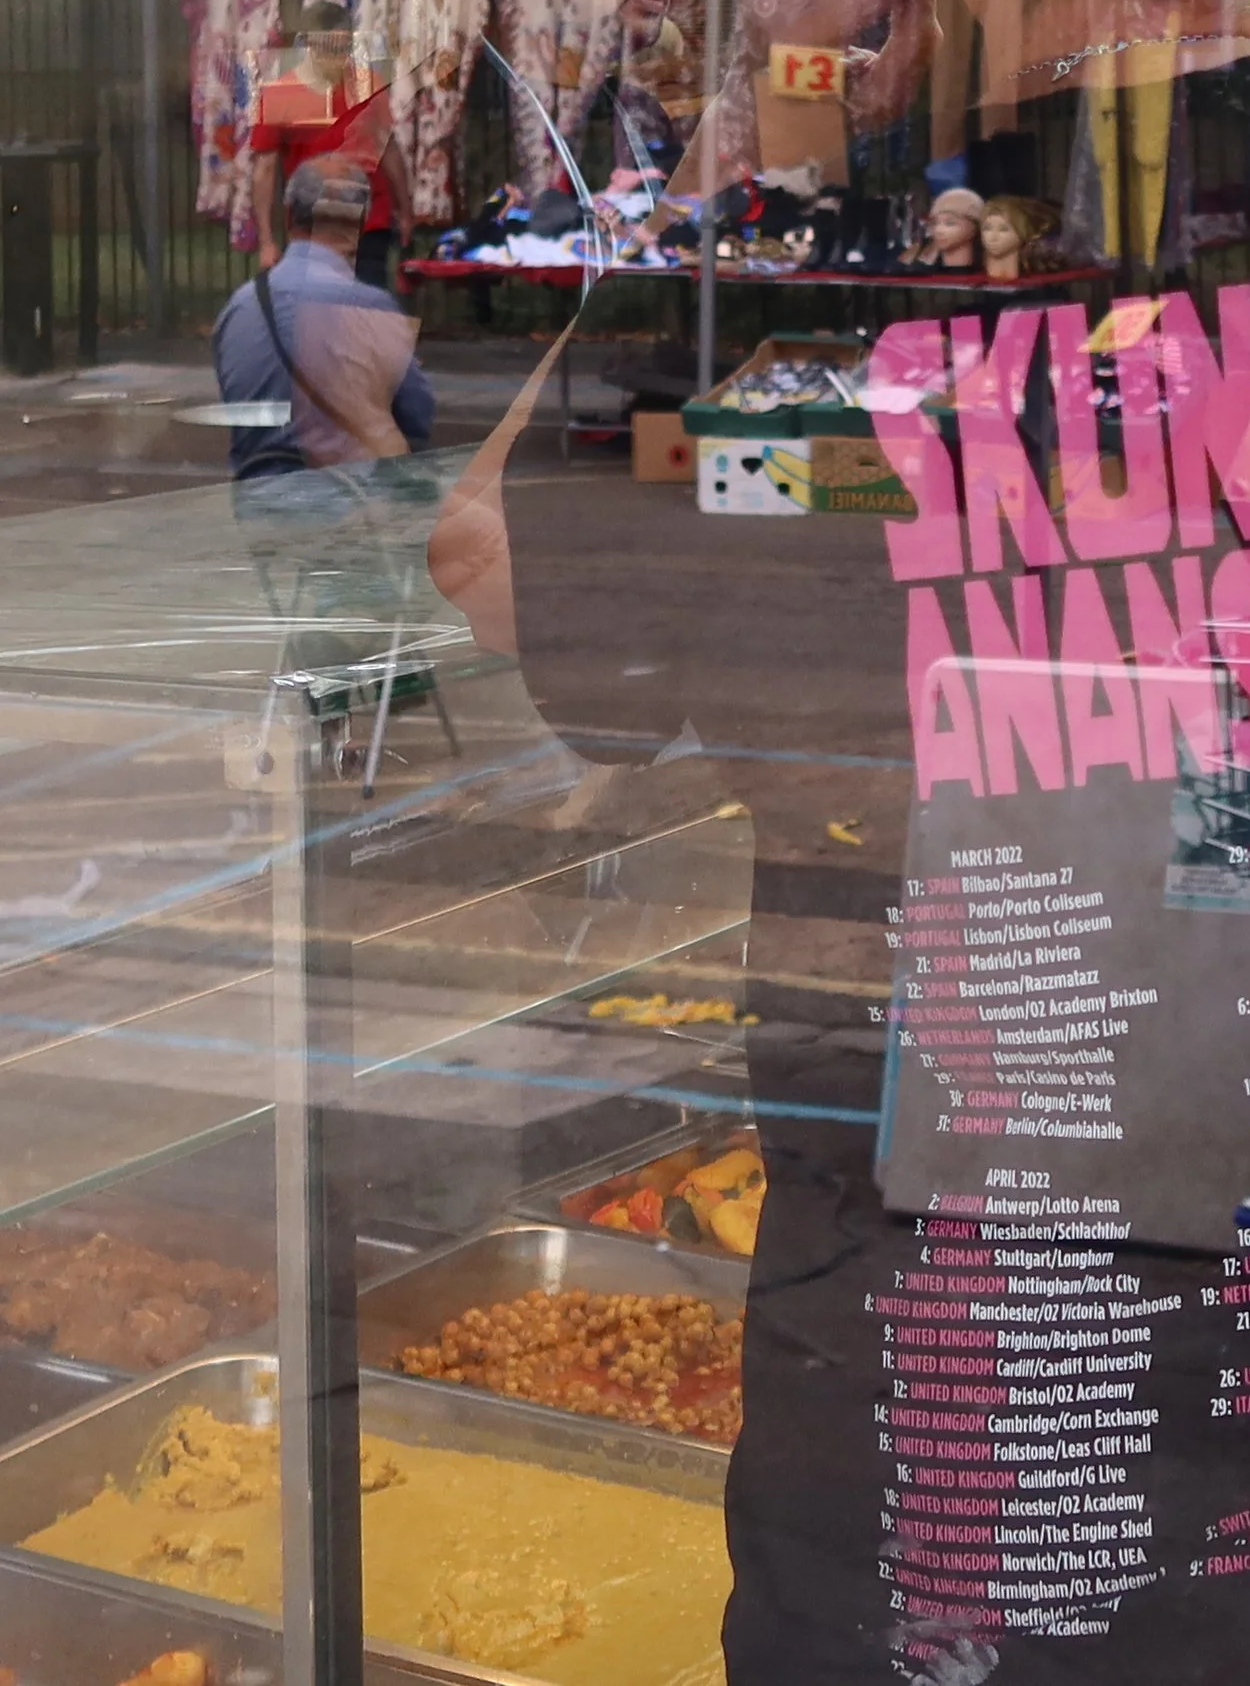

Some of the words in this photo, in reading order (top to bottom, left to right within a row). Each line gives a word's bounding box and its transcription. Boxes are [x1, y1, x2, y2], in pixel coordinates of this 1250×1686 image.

[951, 849, 992, 868] MARCH
[995, 846, 1023, 865] 2022
[907, 879, 924, 897] 17:
[927, 877, 960, 894] SPAIN
[962, 868, 1057, 894] Bilbao/Santana
[1060, 867, 1073, 885] 27
[916, 956, 931, 973] 21:
[933, 955, 968, 972] SPAIN
[970, 952, 1032, 971] Madrid/La
[1036, 945, 1081, 964] Riviera
[950, 1090, 964, 1108] 30:
[967, 1092, 1018, 1109] GERMANY
[1022, 1091, 1112, 1113] Cologne/E-Werk
[985, 1168, 1017, 1189] APRIL
[1021, 1171, 1050, 1189] 2022
[921, 1249, 930, 1264] 4:
[933, 1249, 991, 1266] GERMANY
[994, 1248, 1114, 1270] Stuttgart/Longhorn
[895, 1271, 904, 1289] 7:
[906, 1274, 944, 1292] UNITED
[948, 1276, 1005, 1294] KINGDOM
[1009, 1275, 1112, 1297] Nottingham/Rock
[1116, 1274, 1140, 1294] City
[893, 1379, 907, 1399] 12:
[911, 1383, 949, 1402] UNITED
[953, 1385, 1006, 1404] KINGDOM
[1077, 1381, 1135, 1402] Academy
[897, 1463, 912, 1483] 16:
[915, 1466, 954, 1487] UNITED
[958, 1469, 1015, 1489] KINGDOM
[1018, 1465, 1095, 1490] Guildford/G
[1099, 1464, 1126, 1484] Live
